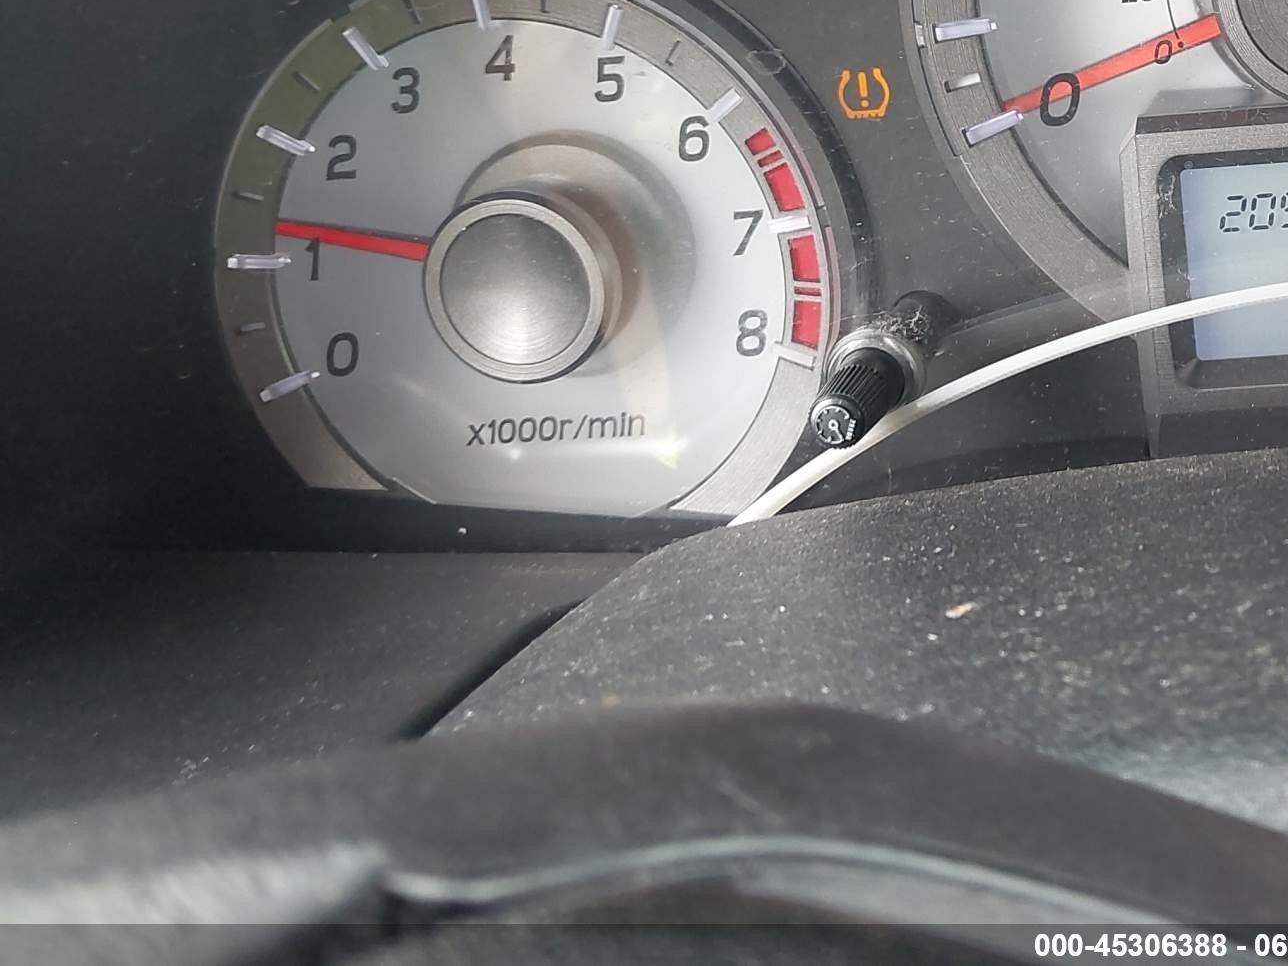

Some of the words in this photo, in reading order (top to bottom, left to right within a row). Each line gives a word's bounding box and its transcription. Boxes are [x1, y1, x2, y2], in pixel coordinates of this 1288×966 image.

[485, 34, 516, 82] 4
[1153, 39, 1172, 65] 0
[391, 66, 420, 114] 3
[594, 55, 625, 102] 5
[1039, 73, 1081, 127] 0
[326, 134, 357, 181] 2
[678, 115, 710, 162] 6
[732, 210, 764, 256] 7
[306, 238, 320, 281] 1
[326, 332, 359, 377] 0
[736, 310, 767, 357] 8
[467, 411, 646, 446] x1000r/min
